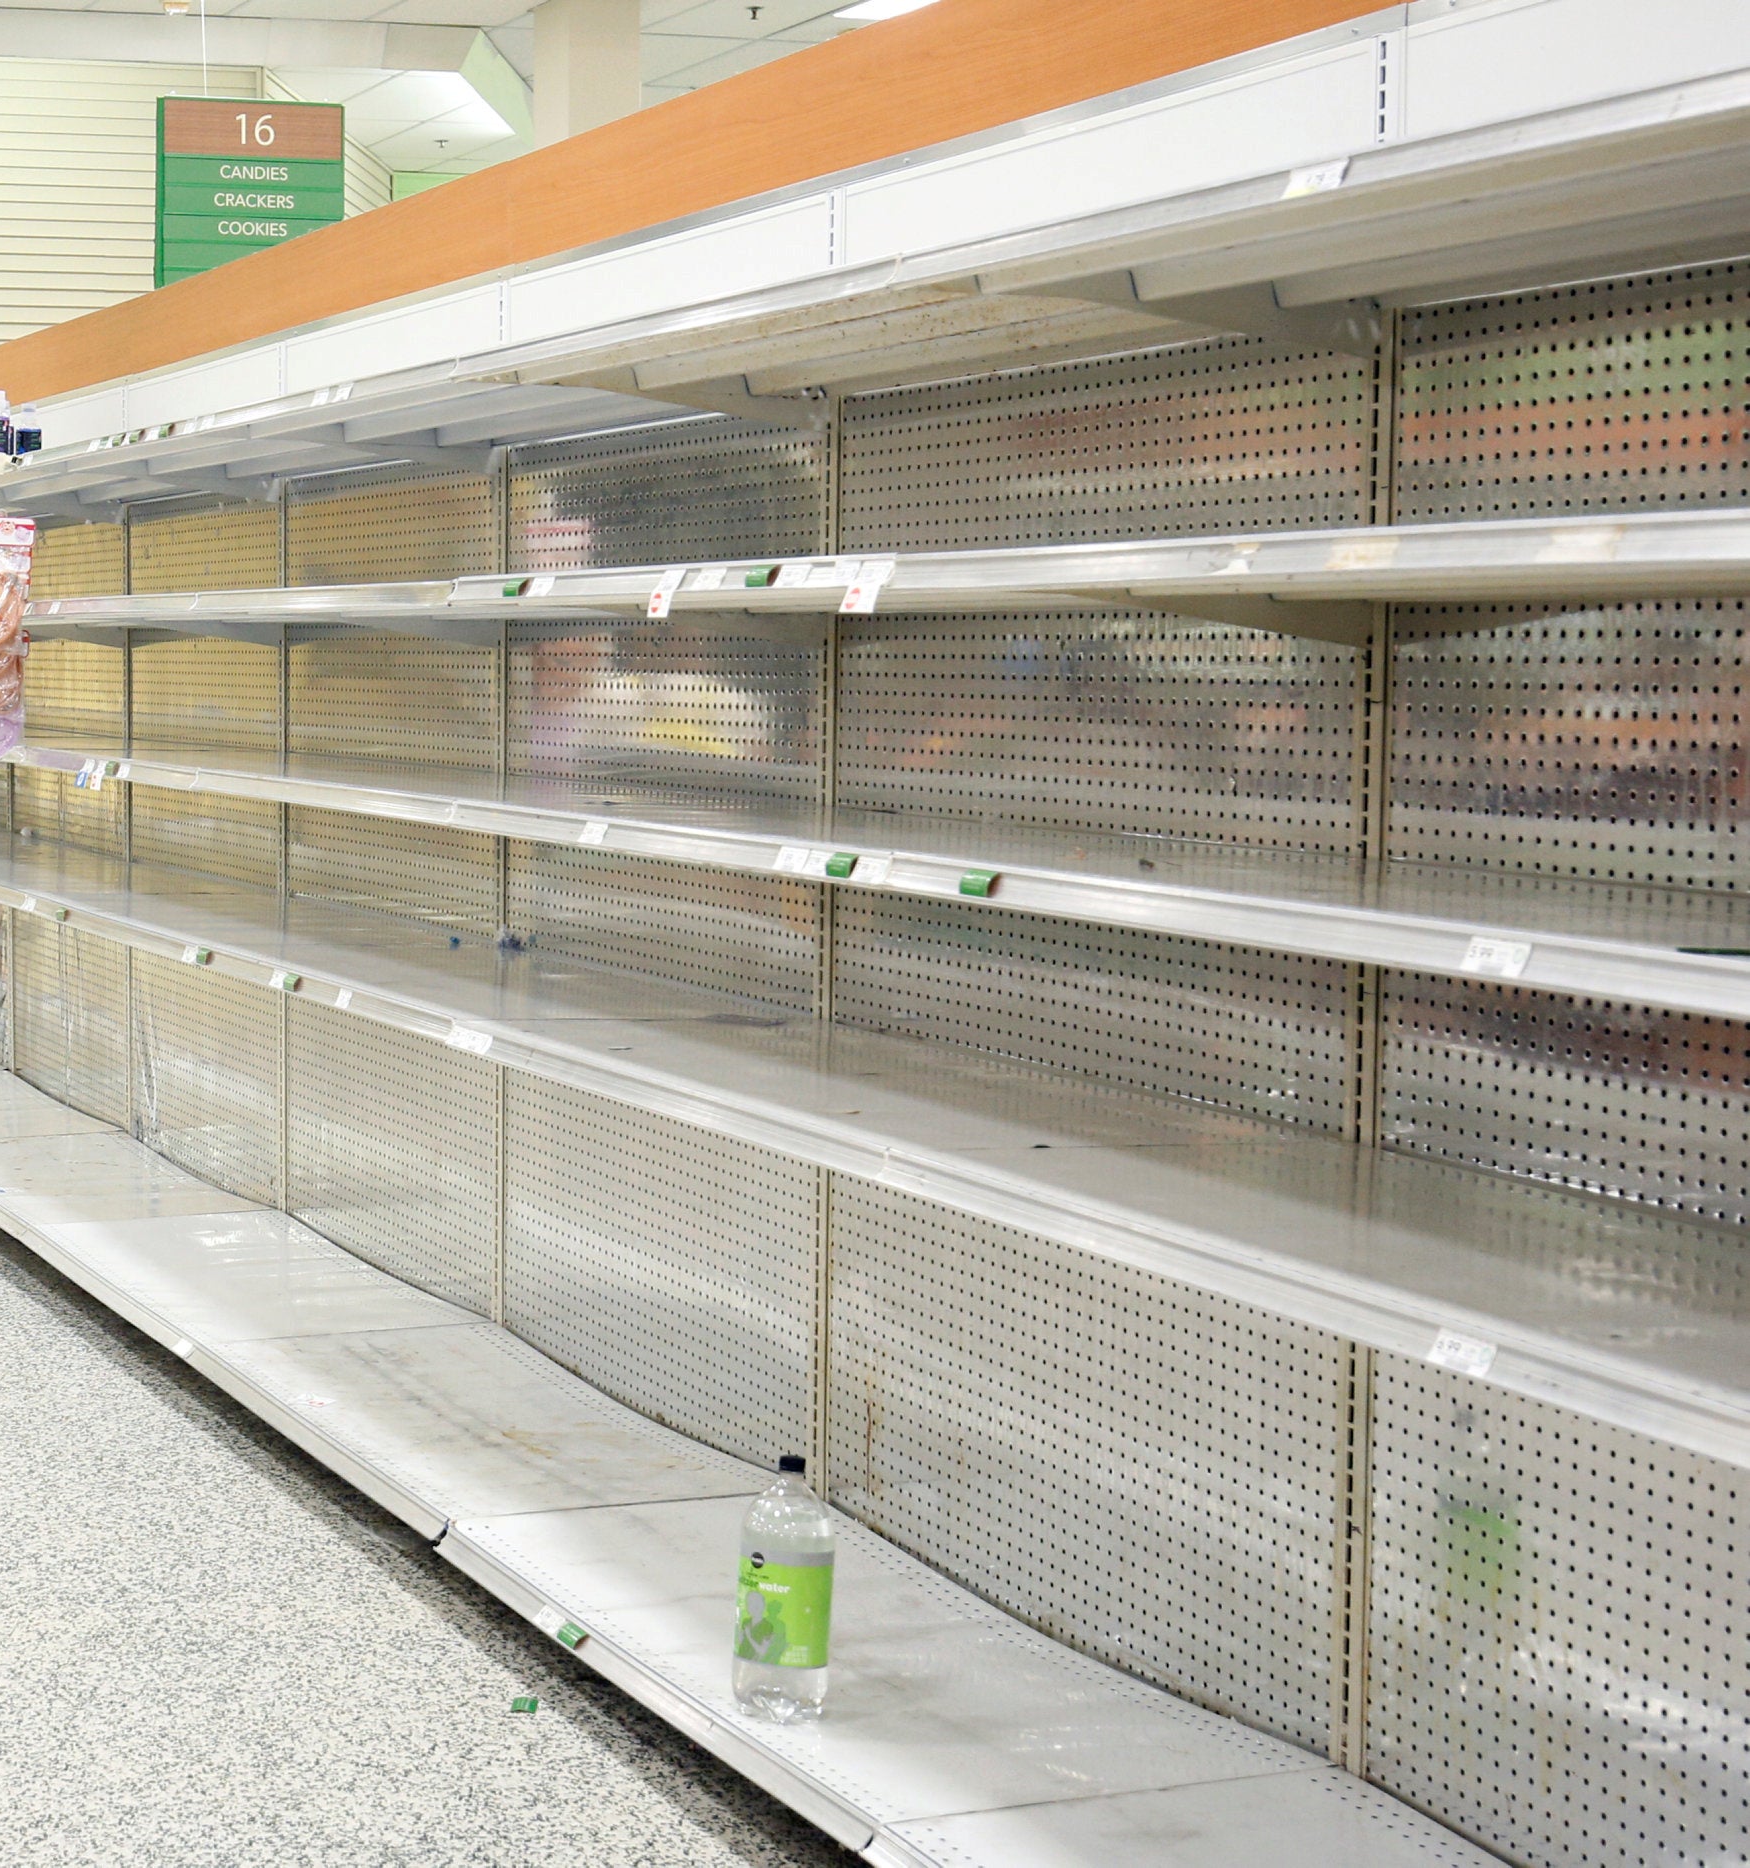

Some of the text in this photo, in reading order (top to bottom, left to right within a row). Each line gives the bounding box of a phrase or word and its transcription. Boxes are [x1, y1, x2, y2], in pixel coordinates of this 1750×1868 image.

[235, 113, 275, 146] 16
[219, 164, 288, 181] CANDIES
[213, 192, 295, 209] CRACKERS
[217, 220, 288, 237] COOKIES
[758, 1582, 791, 1594] water
